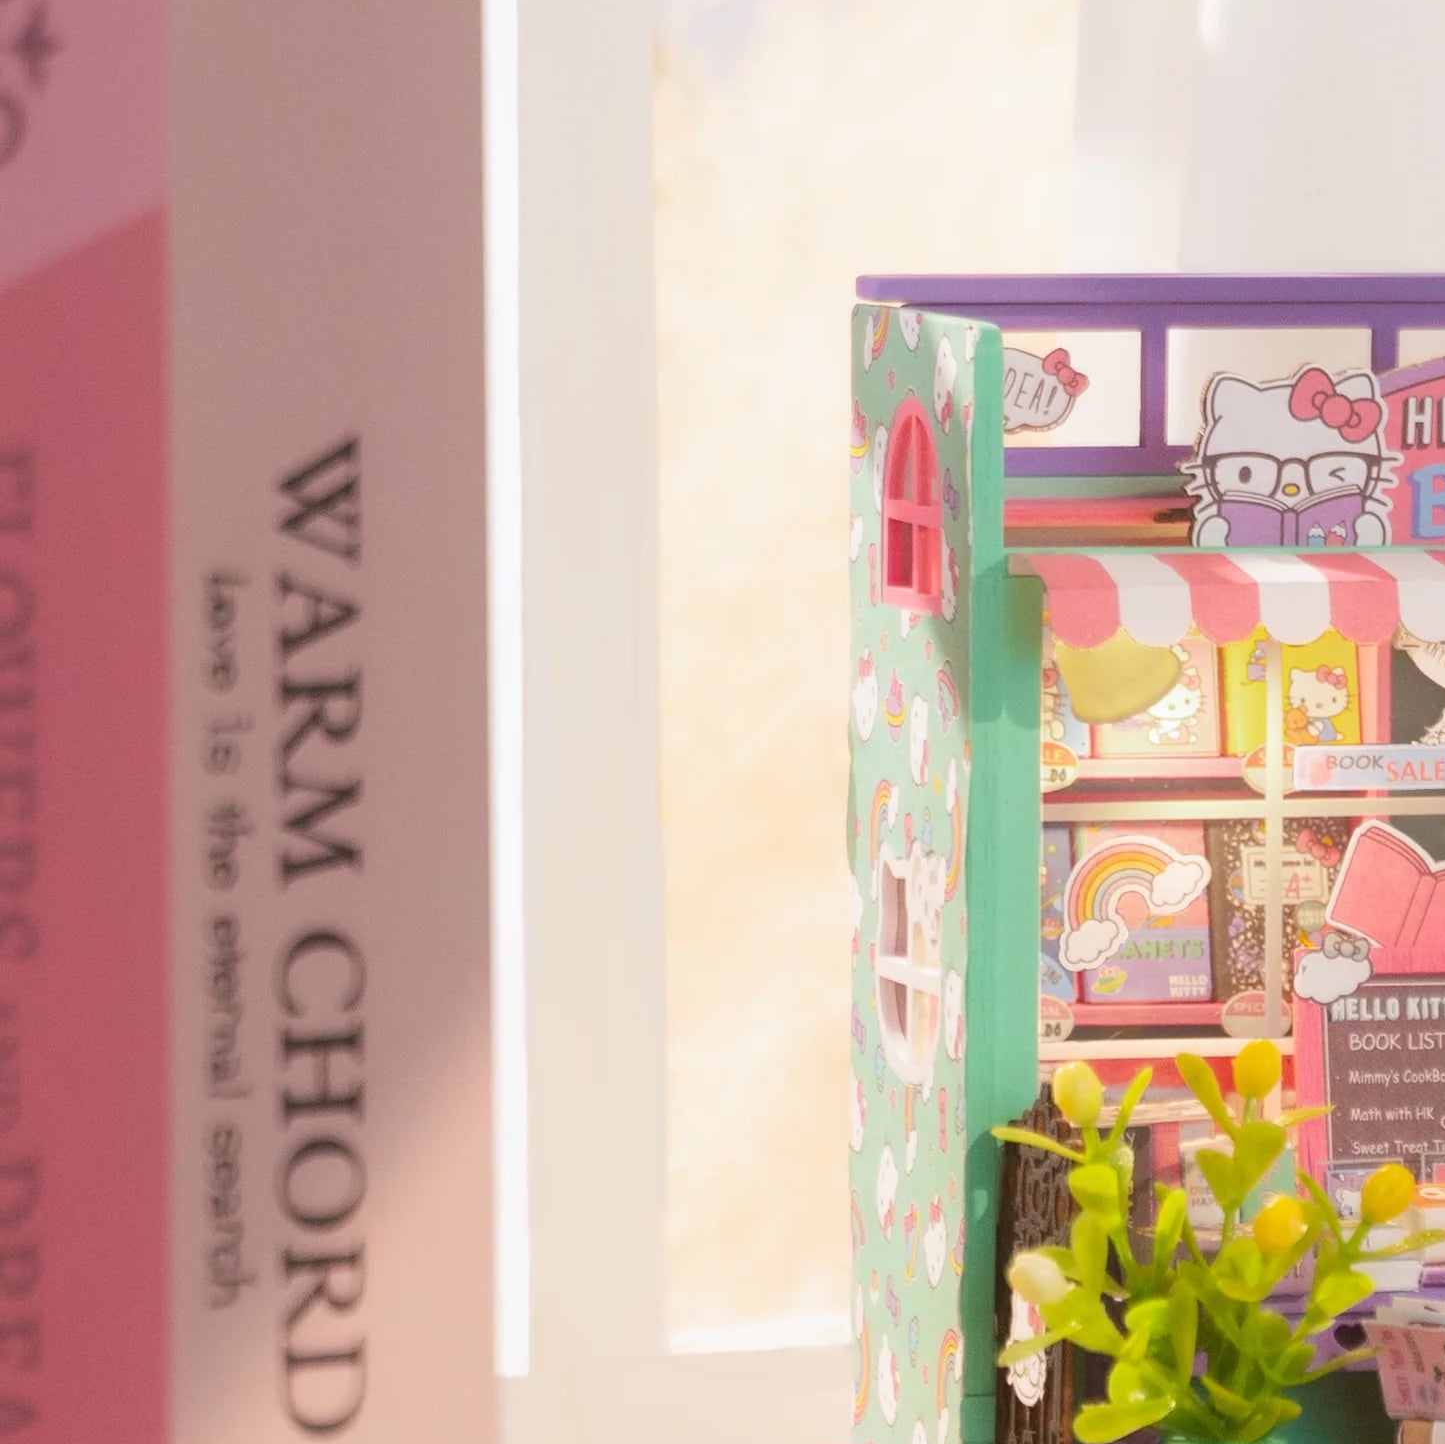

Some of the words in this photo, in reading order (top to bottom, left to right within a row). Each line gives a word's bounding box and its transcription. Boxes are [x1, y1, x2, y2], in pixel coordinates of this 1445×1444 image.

[1004, 367, 1058, 415] DEA!
[276, 434, 363, 891] WARM
[1326, 755, 1384, 770] BOOK
[205, 801, 255, 892] the
[1330, 997, 1400, 1022] HELLO
[1350, 1033, 1401, 1051] BOOK
[1349, 1070, 1400, 1087] Mimmy's
[1351, 1108, 1383, 1122] Math
[1384, 1108, 1413, 1122] with
[1415, 1108, 1435, 1121] HK
[1352, 1141, 1390, 1155] Sweet
[1394, 1140, 1430, 1154] Treat
[275, 929, 368, 1435] CHORD
